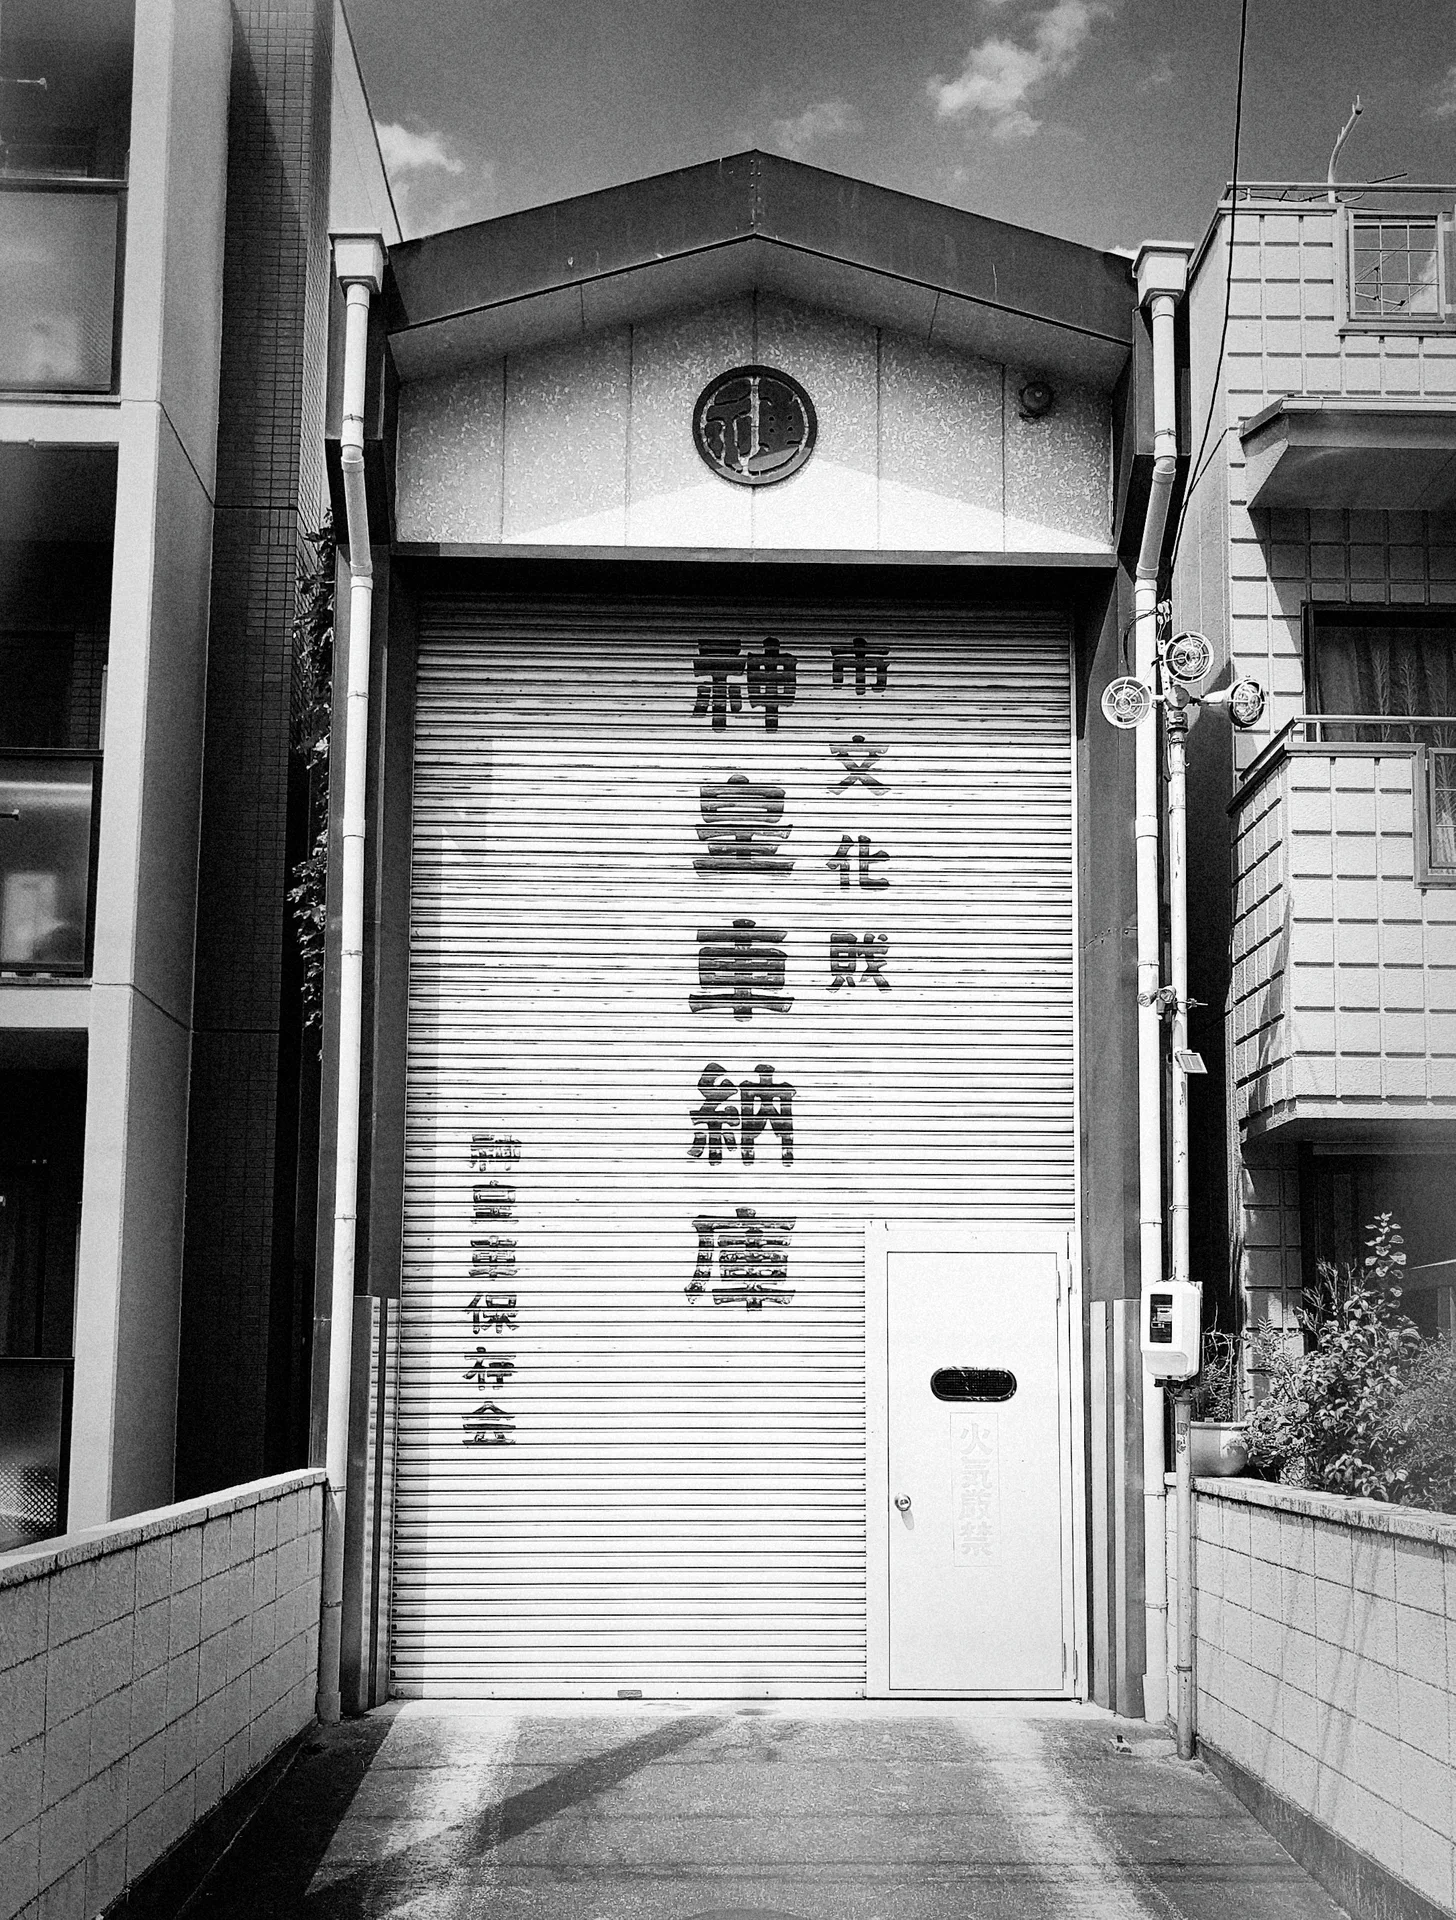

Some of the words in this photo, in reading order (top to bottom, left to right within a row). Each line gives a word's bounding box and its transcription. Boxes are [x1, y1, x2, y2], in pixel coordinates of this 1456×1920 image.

[684, 635, 798, 1312] 神皇車納庫
[461, 1134, 522, 1448] 神皇車保存会
[957, 1421, 994, 1557] 火気厳禁
